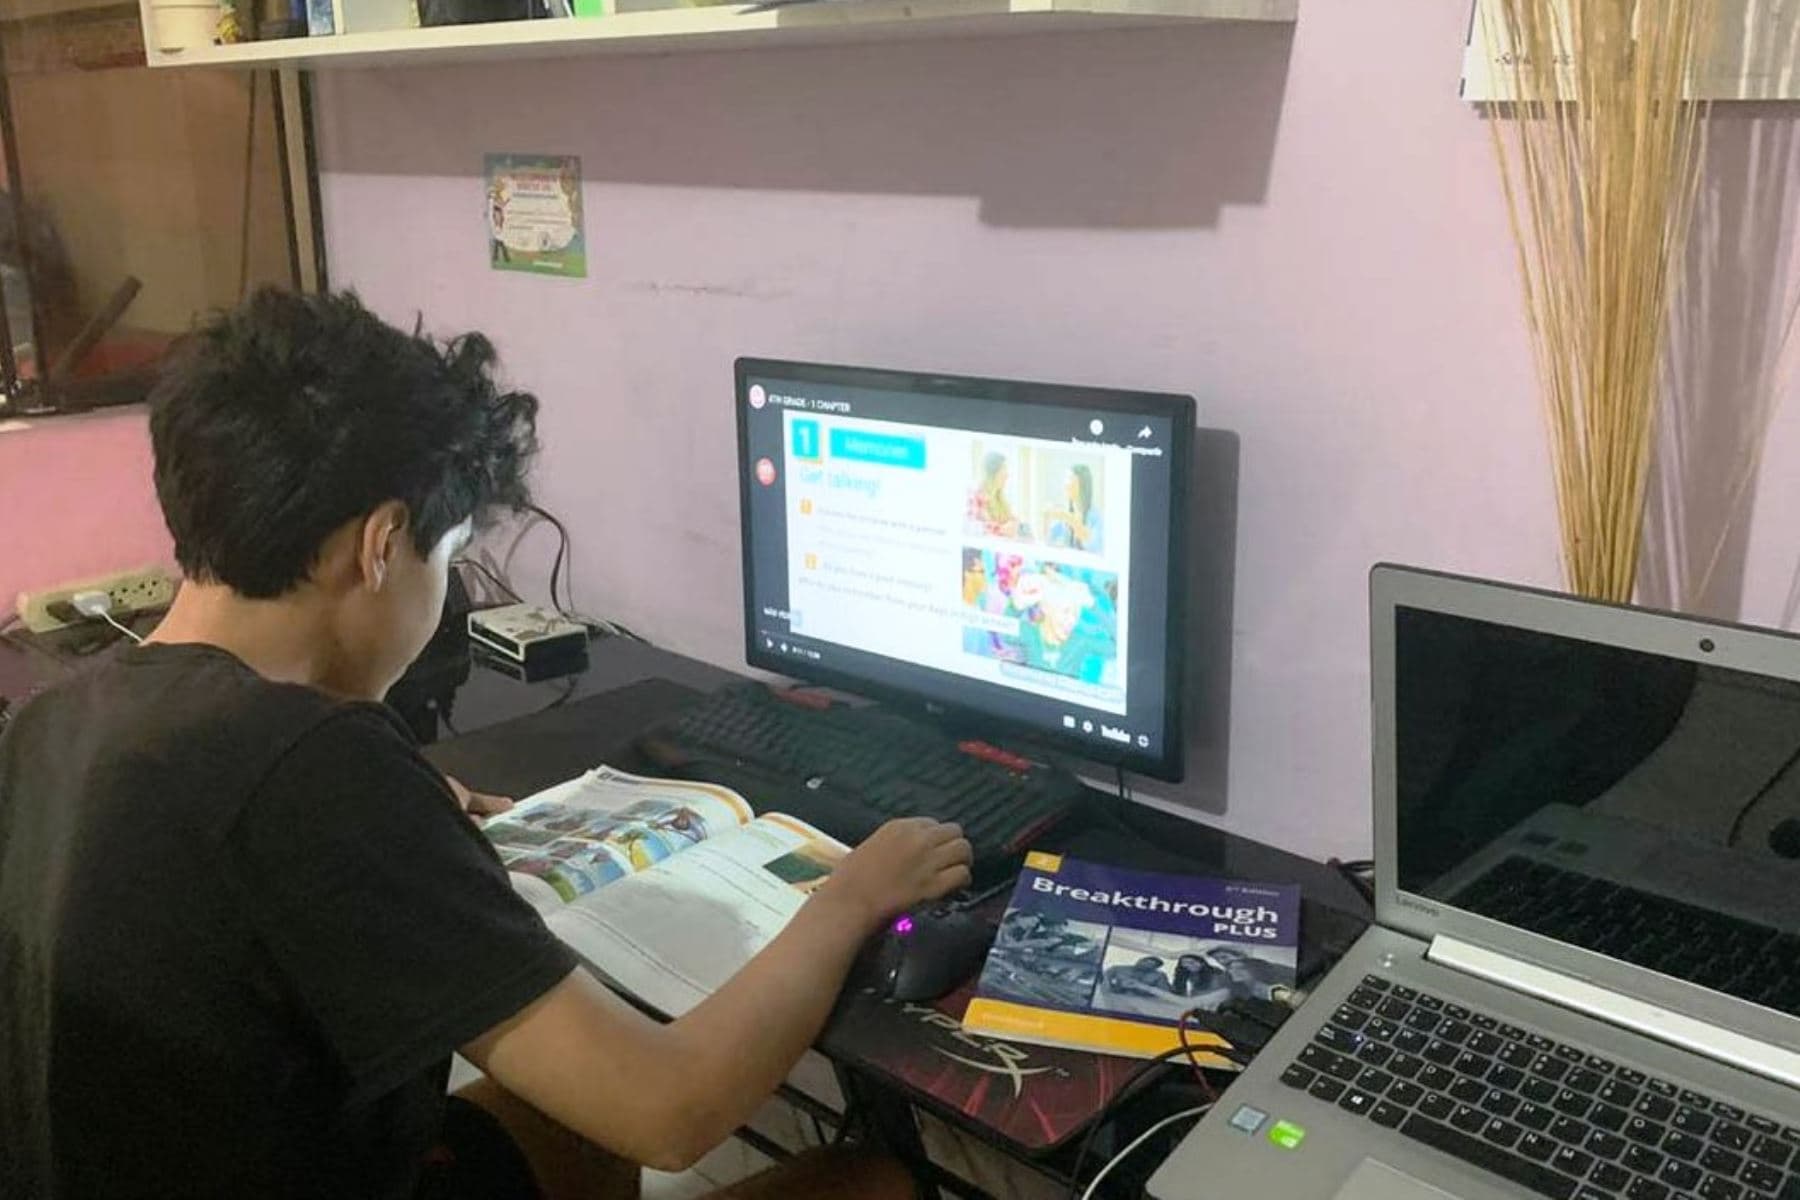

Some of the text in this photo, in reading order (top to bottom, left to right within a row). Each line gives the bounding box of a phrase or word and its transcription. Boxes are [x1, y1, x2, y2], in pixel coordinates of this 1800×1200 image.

[817, 400, 851, 413] CHAPTER
[799, 426, 811, 454] 1
[1032, 876, 1279, 925] Breakthrough
[1213, 922, 1279, 939] PLUS
